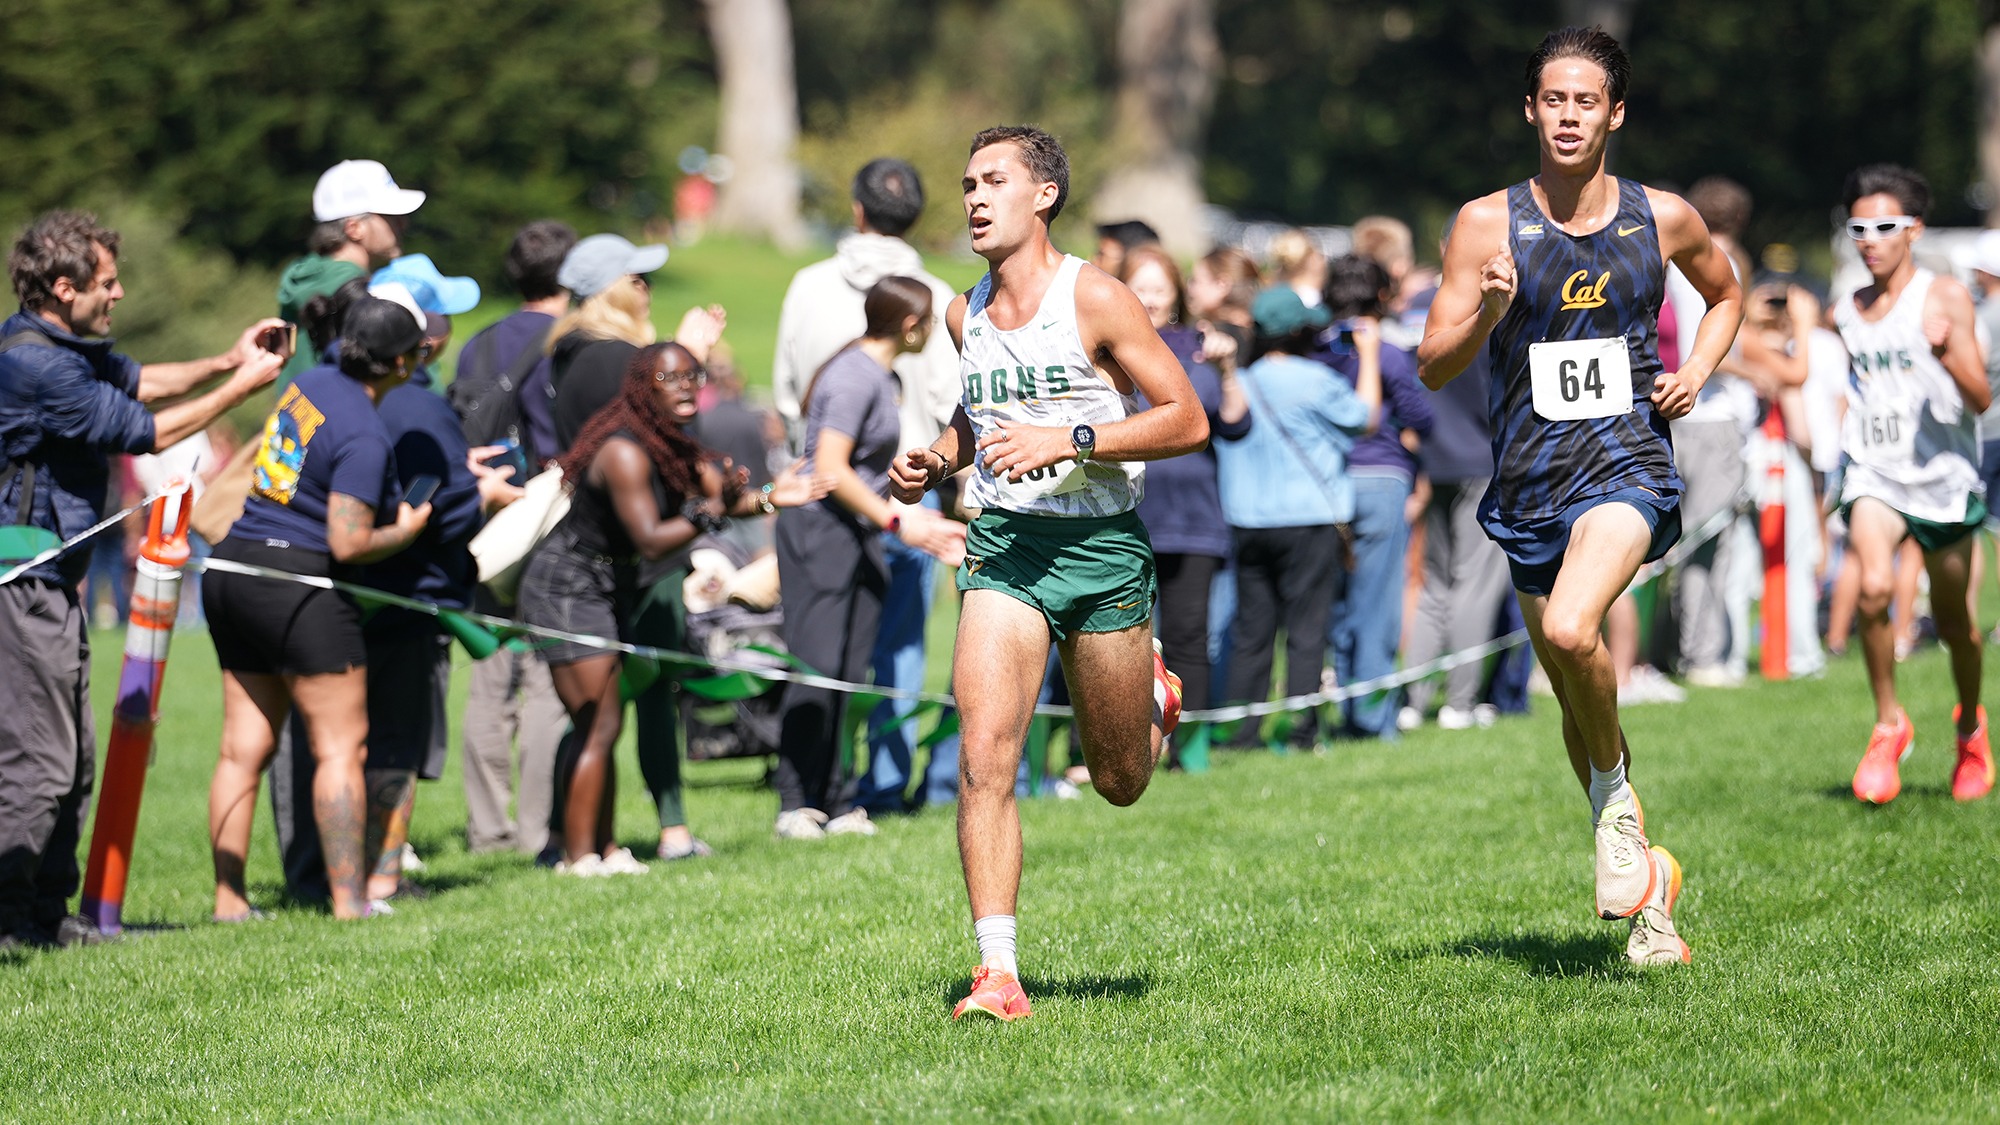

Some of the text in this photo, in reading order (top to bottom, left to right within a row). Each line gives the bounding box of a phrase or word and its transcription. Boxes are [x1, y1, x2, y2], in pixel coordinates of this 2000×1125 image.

[1560, 269, 1611, 311] Cal
[967, 365, 1071, 404] DONS
[1559, 357, 1605, 403] 64
[1861, 412, 1900, 448] 160
